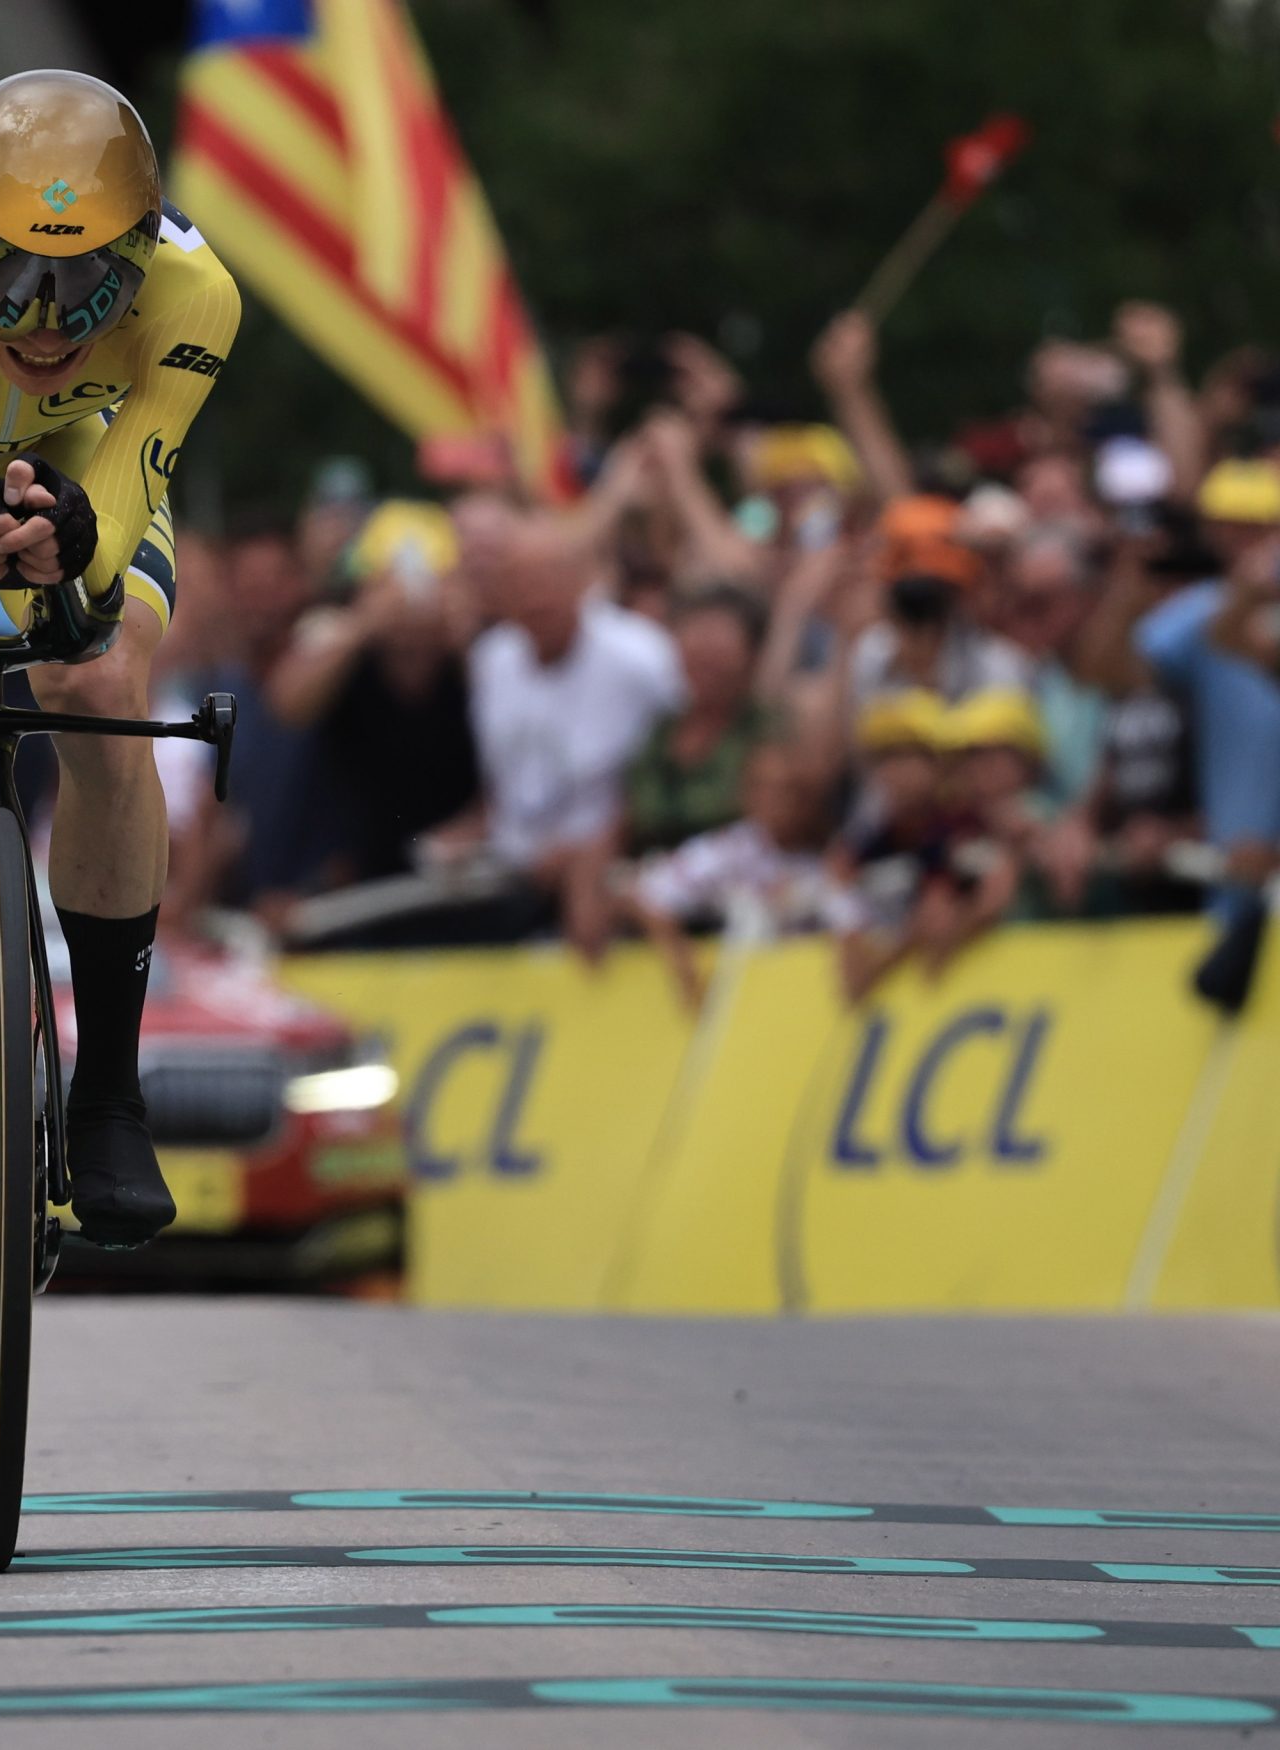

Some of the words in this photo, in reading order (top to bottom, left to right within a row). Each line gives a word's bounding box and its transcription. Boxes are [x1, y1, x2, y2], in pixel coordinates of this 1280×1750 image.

[29, 223, 85, 235] LAZER
[149, 437, 183, 479] LC
[404, 1014, 548, 1182] CL
[828, 1004, 1052, 1169] LCL
